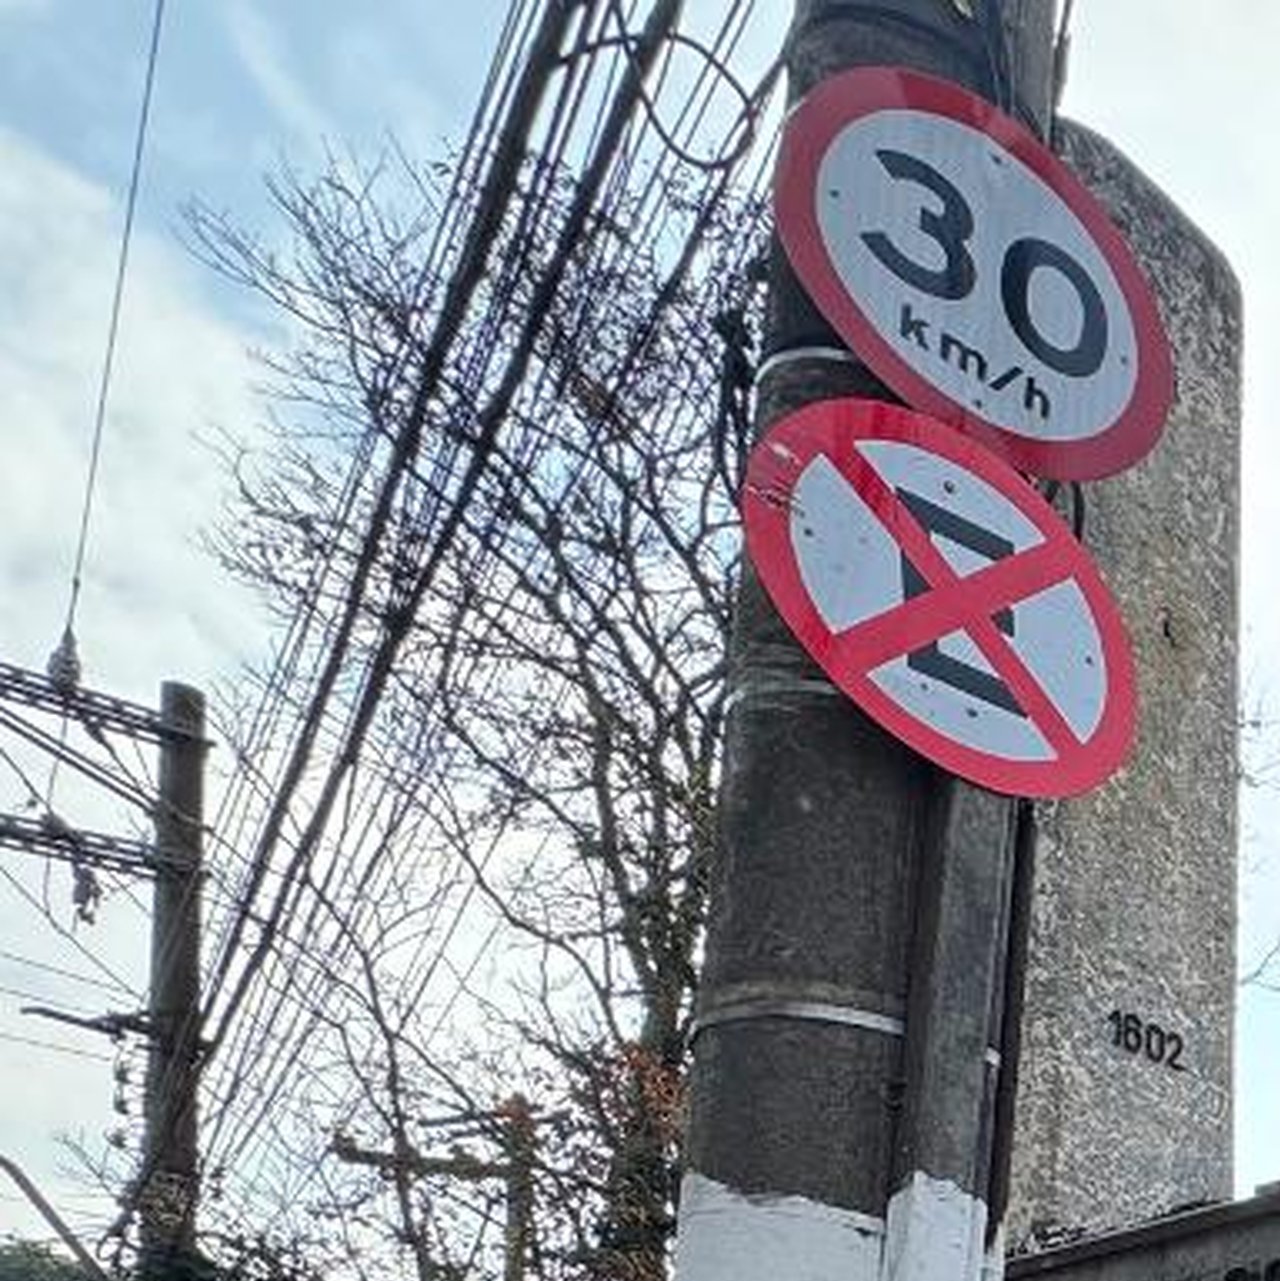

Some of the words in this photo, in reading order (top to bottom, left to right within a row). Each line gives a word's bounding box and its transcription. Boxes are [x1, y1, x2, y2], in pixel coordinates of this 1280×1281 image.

[859, 149, 1107, 378] 30
[900, 304, 1052, 423] km/h
[1107, 1008, 1187, 1072] 1602
